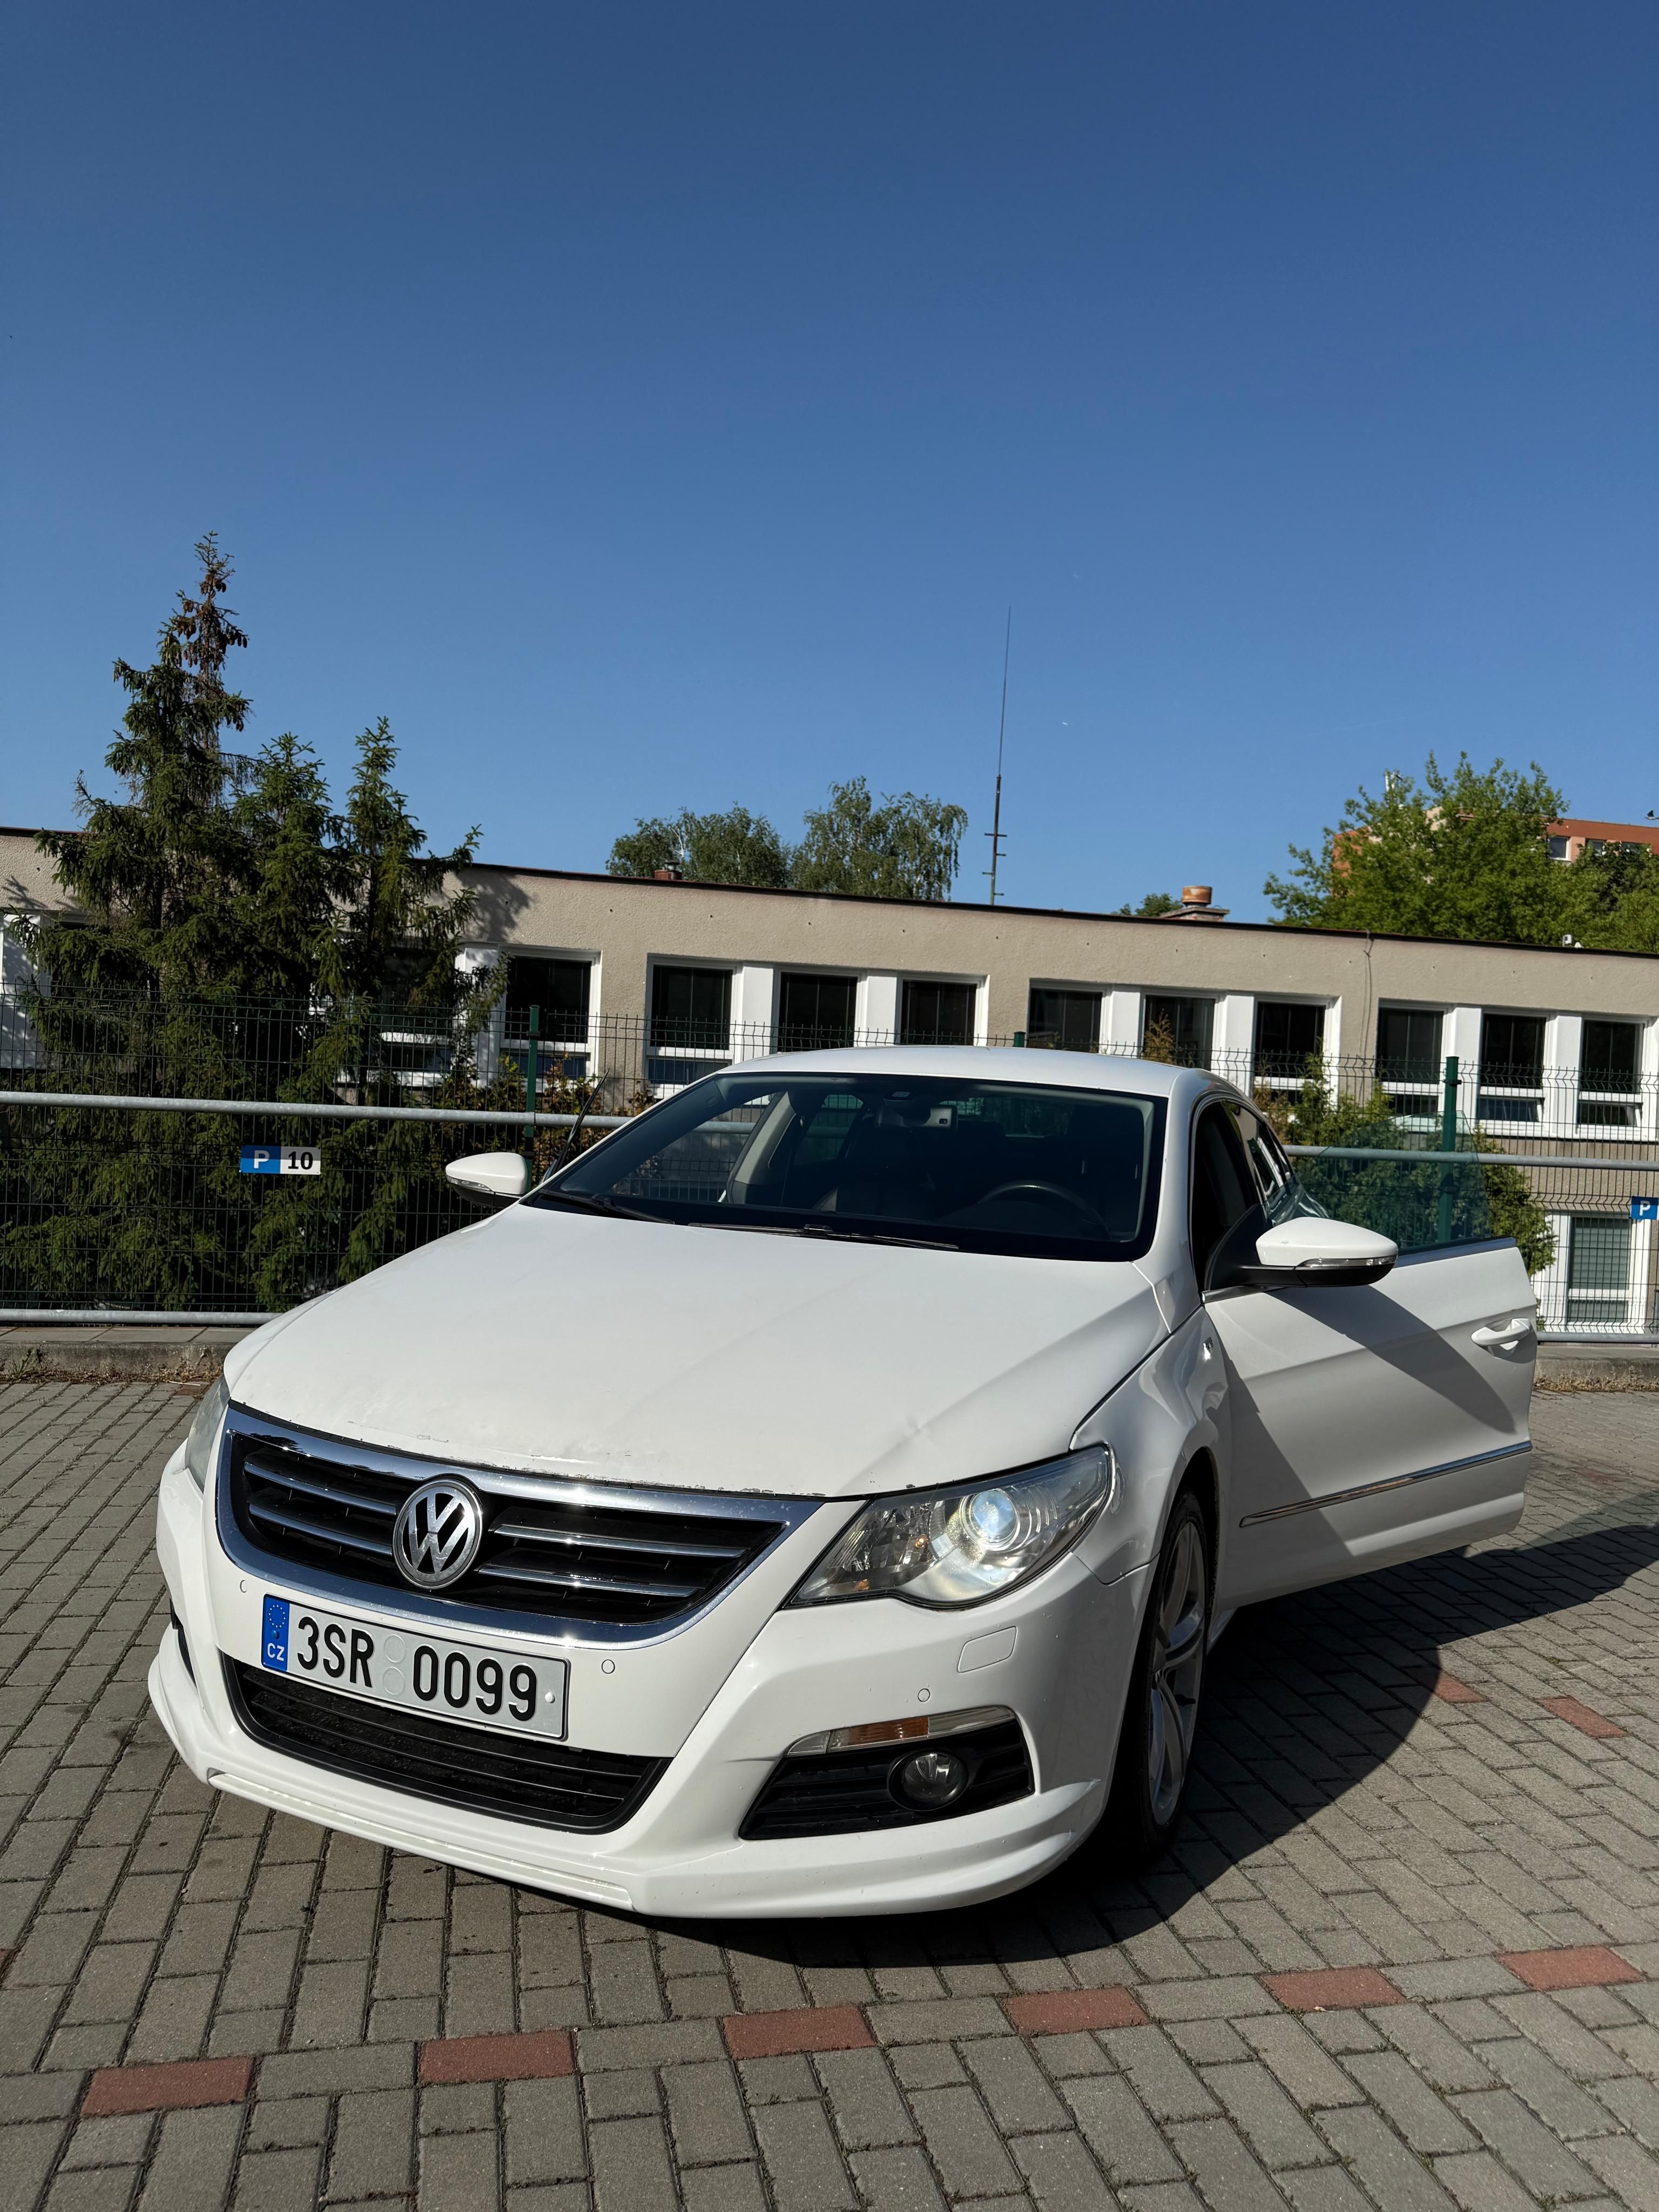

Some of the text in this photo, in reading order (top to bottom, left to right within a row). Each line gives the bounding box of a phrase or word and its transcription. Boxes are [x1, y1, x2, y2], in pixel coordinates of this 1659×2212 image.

[253, 1150, 313, 1170] P 10
[1639, 1201, 1651, 1216] P
[397, 1482, 480, 1586] VW
[267, 1642, 285, 1661] CZ
[297, 1616, 537, 1722] 3SR 0099
